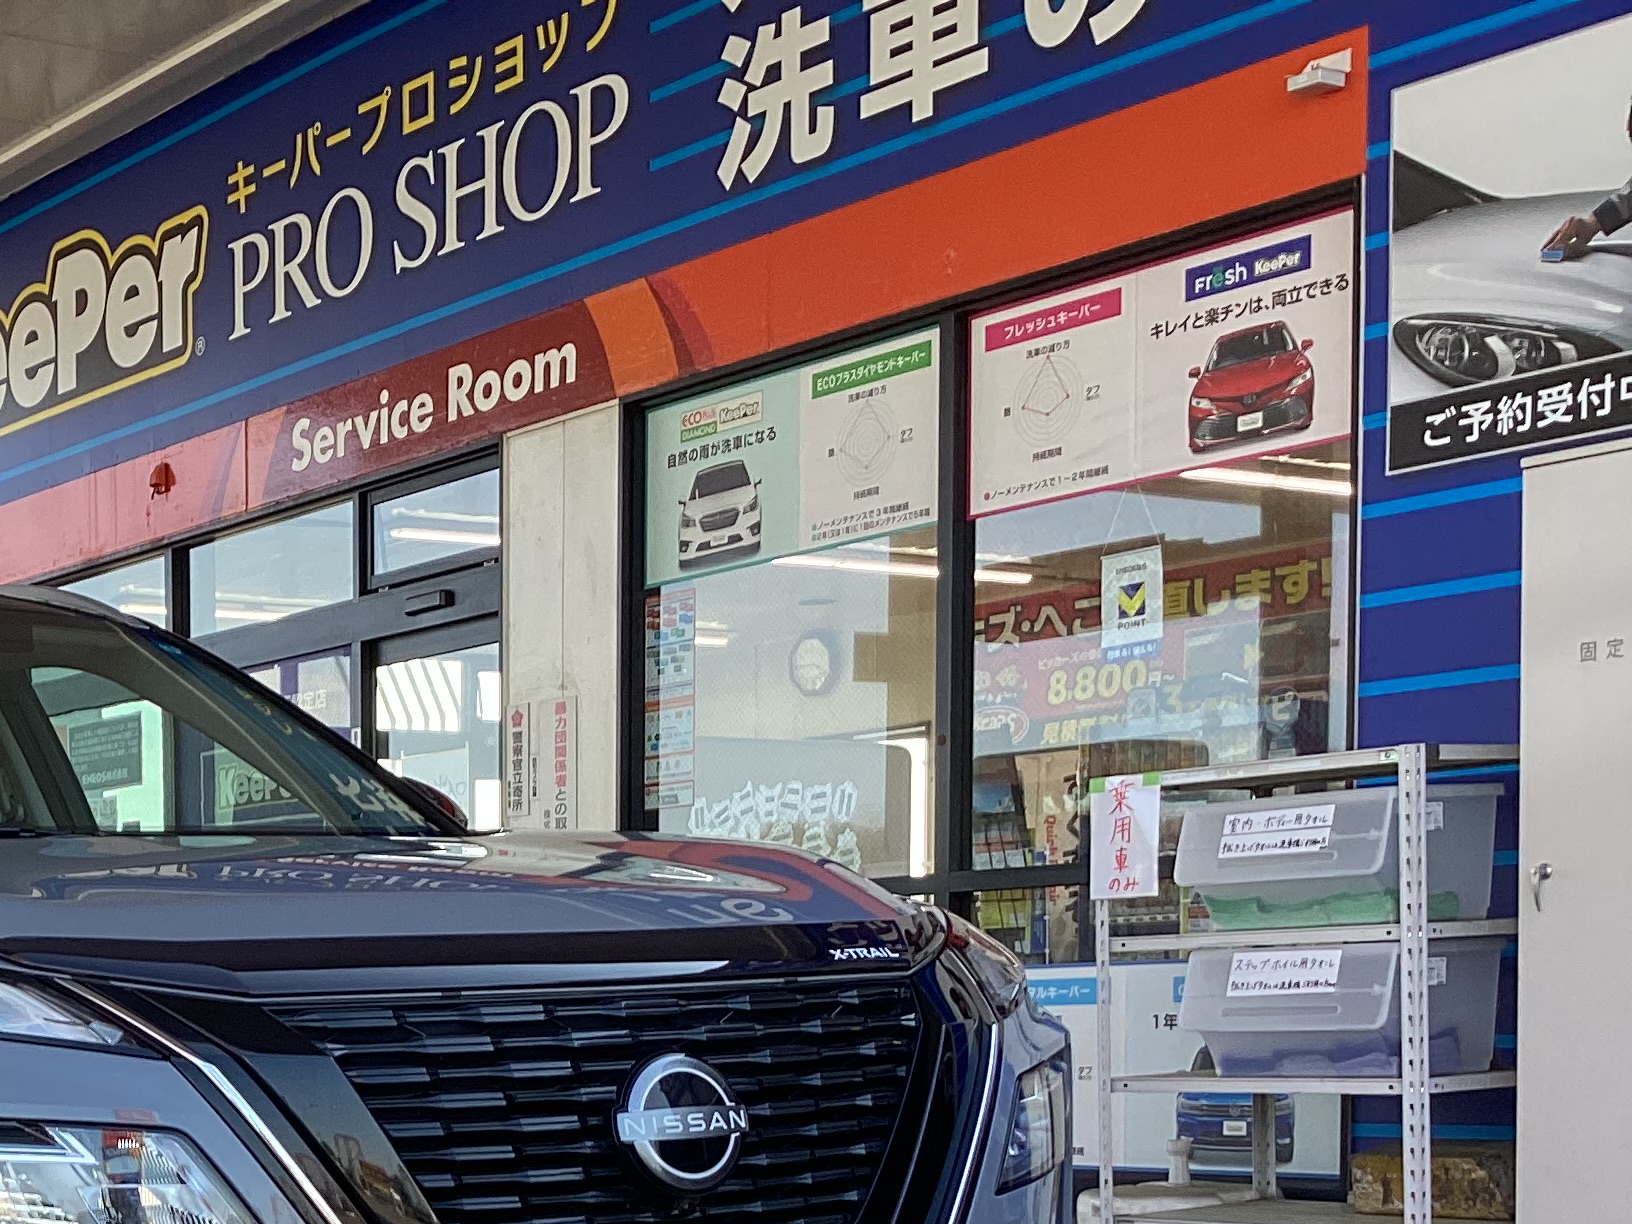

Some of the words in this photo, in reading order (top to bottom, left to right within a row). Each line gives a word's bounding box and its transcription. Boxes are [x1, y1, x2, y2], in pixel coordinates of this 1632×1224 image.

[227, 186, 371, 343] PRO
[392, 73, 629, 276] SHOP
[1194, 261, 1248, 294] Fresh
[1004, 302, 1101, 341] フレッシュキーパー
[1149, 272, 1350, 340] キレイと楽チンは、両立できる
[290, 386, 434, 474] Service
[446, 340, 578, 423] Room
[718, 401, 760, 425] KeePer
[667, 425, 777, 470] 自然の雨が洗車になる
[1108, 779, 1141, 893] 乗用車のみ
[828, 946, 899, 962] X-TRAIL
[623, 1107, 748, 1139] NISSAN
